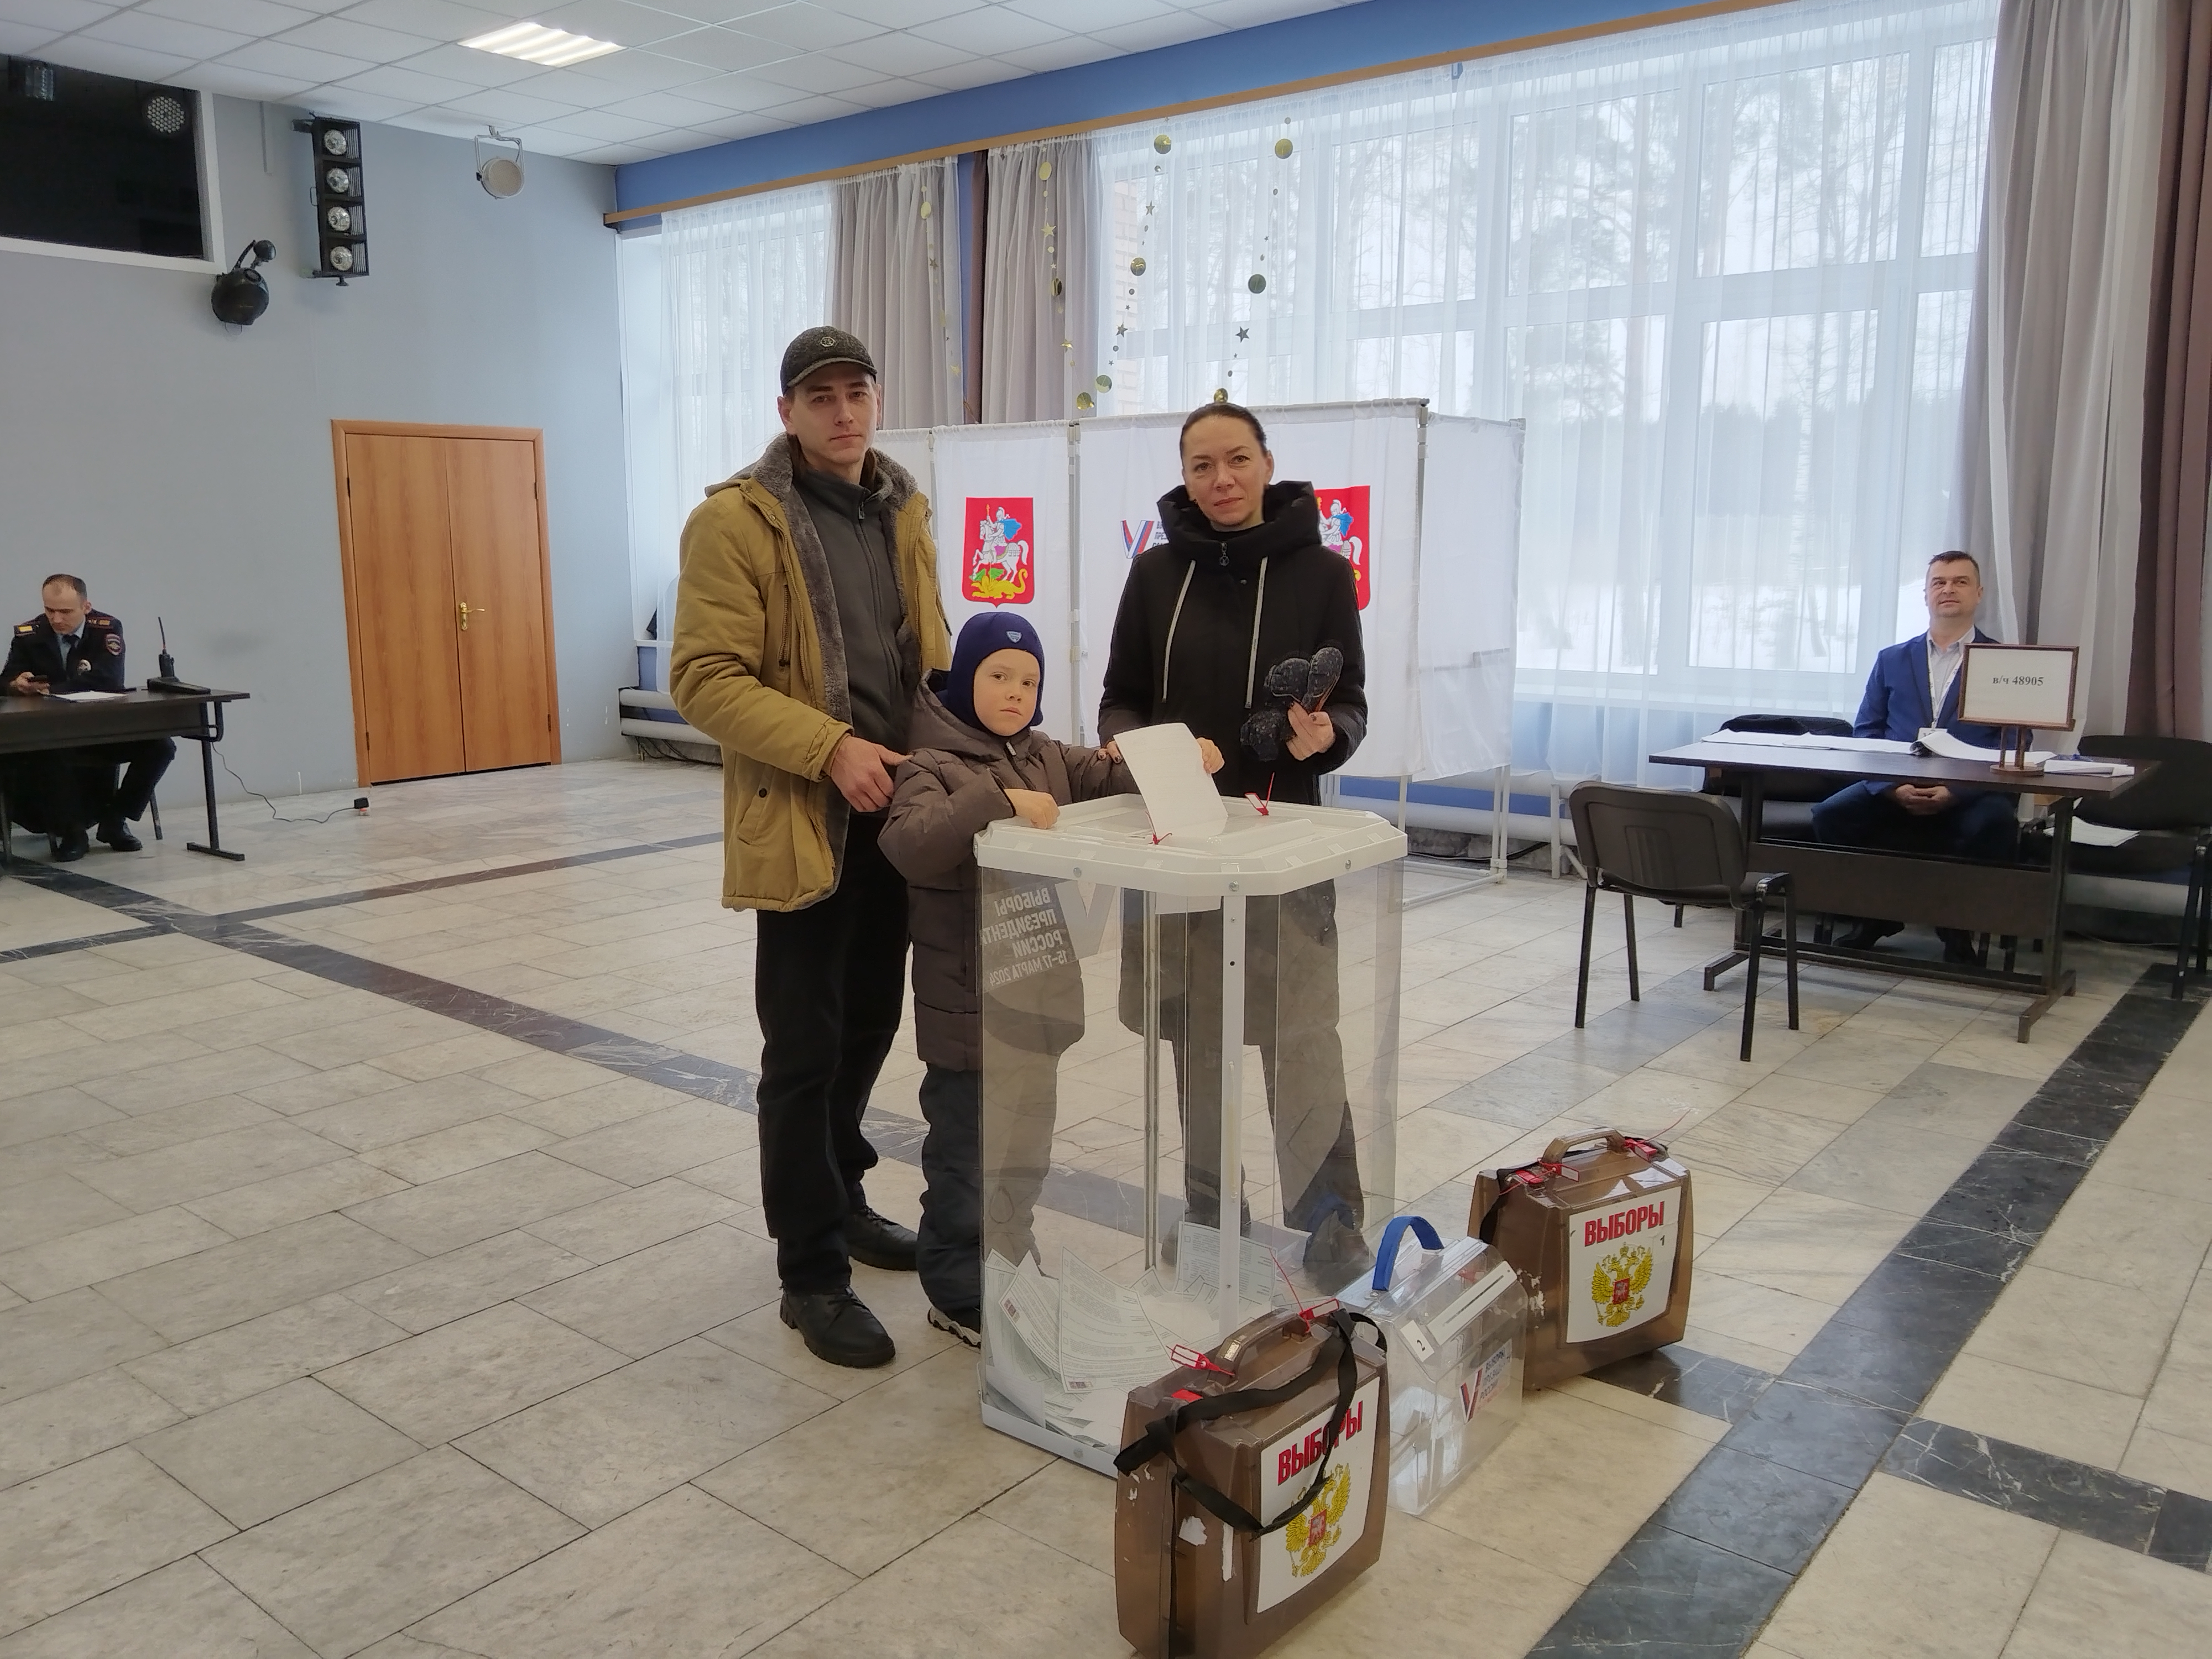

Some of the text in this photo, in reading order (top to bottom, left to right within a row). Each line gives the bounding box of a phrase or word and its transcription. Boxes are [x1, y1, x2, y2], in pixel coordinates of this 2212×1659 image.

[1992, 675, 2044, 686] в/ч 48905
[1584, 1201, 1665, 1246] ВЫБОРЫ
[1660, 1235, 1666, 1246] 1
[1416, 1339, 1426, 1352] 2
